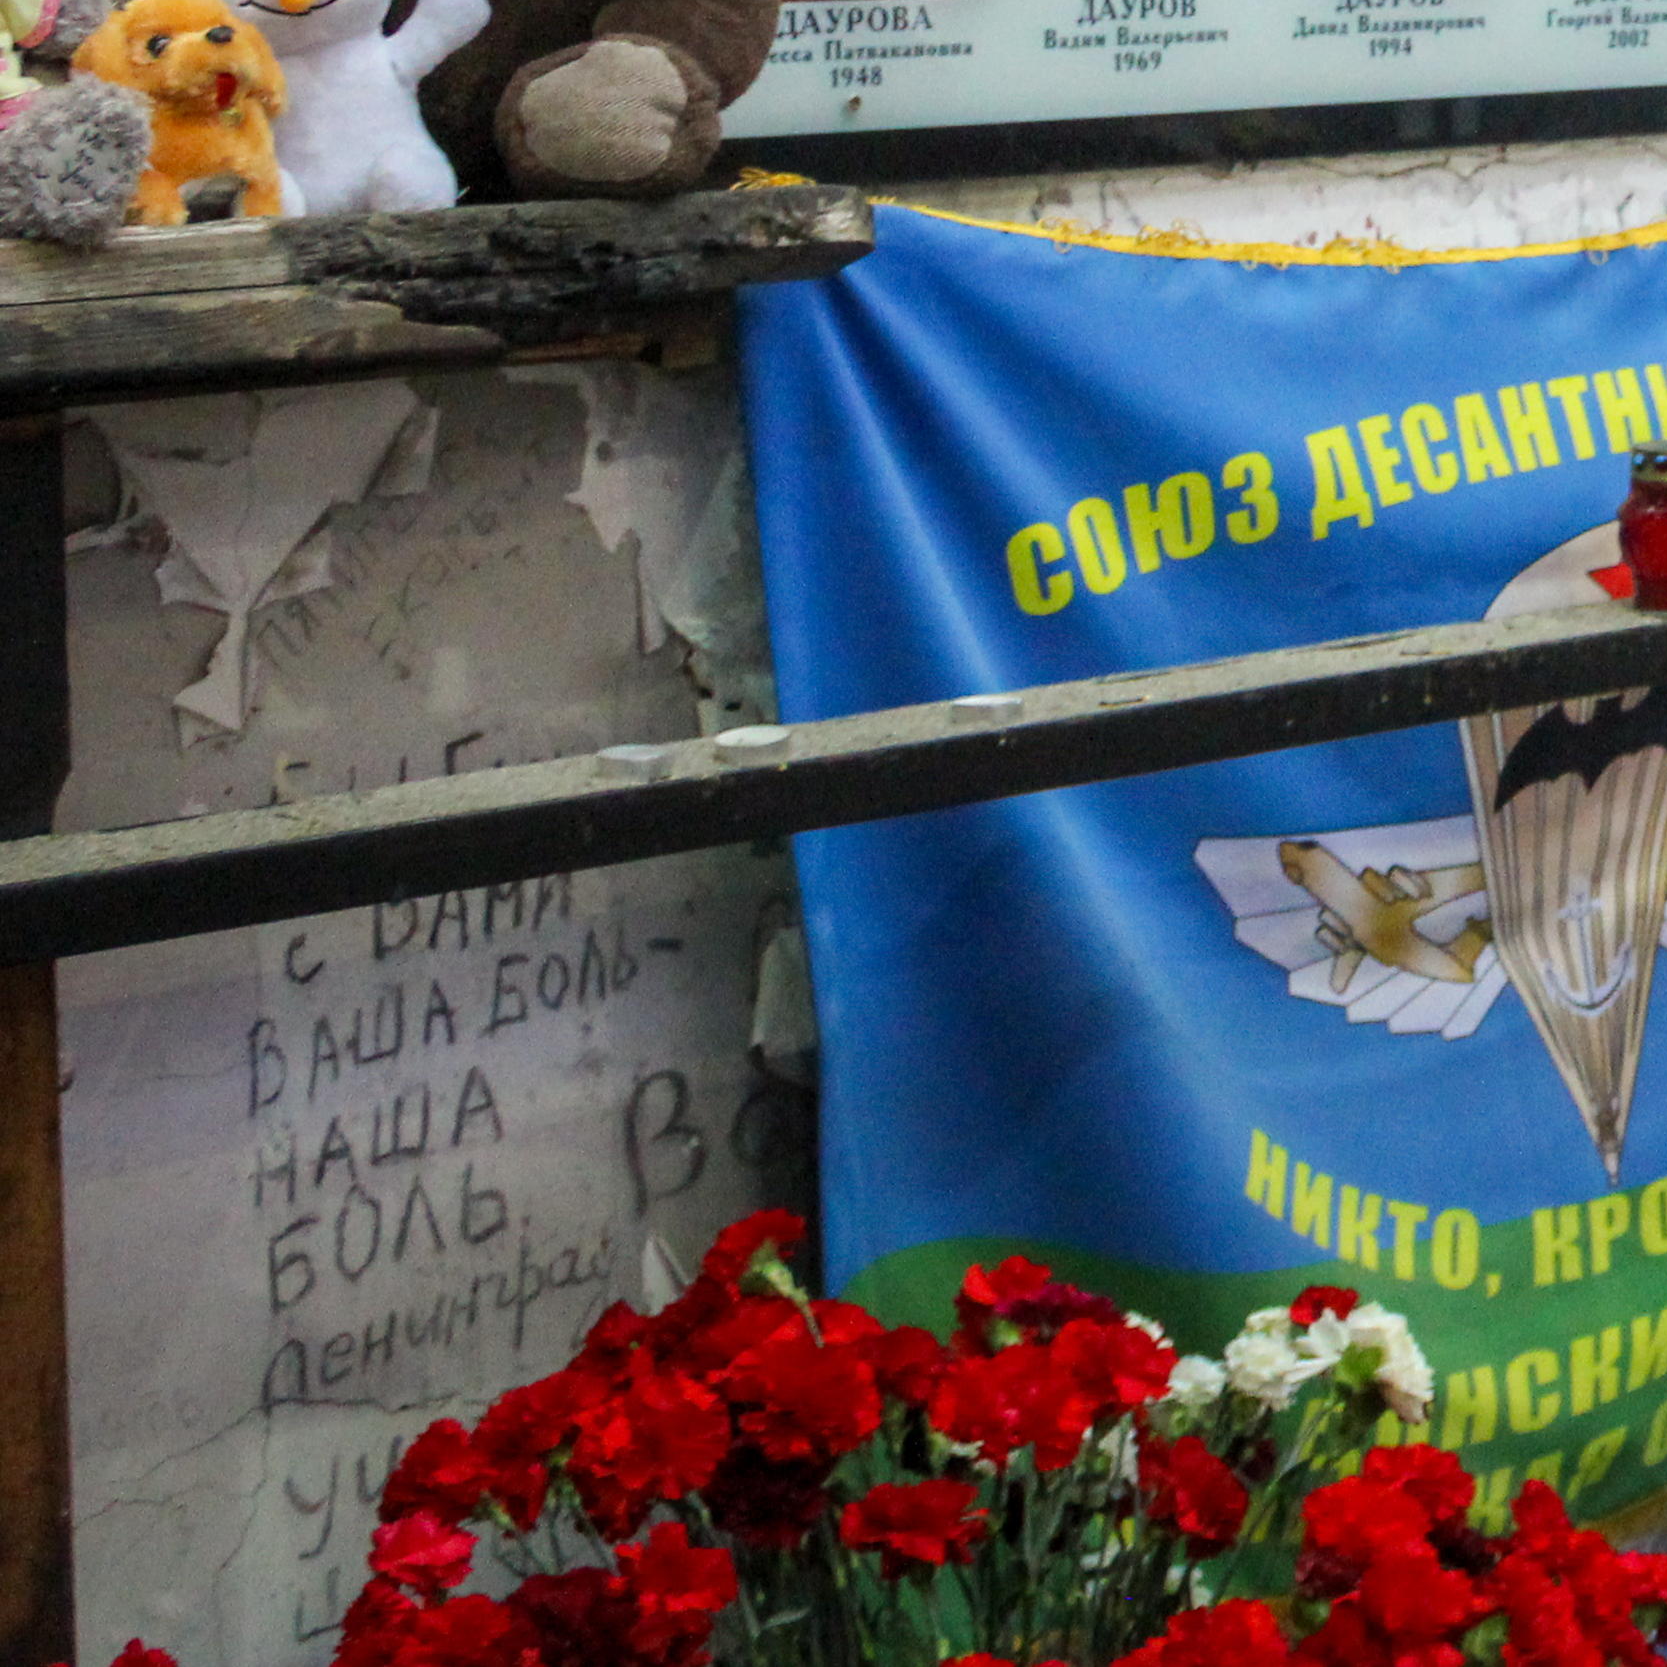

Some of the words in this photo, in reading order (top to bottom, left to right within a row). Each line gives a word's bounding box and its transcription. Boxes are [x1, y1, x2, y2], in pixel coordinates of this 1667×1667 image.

[778, 5, 933, 39] ДАУРОВА
[768, 46, 813, 64] есса
[1114, 50, 1161, 72] 1969
[1368, 38, 1413, 58] 1994
[830, 64, 883, 88] 1948
[1006, 449, 1278, 617] СОЮЗ
[248, 983, 456, 1120] ВАША
[251, 1065, 503, 1207] НАША
[1244, 1129, 1502, 1298] НИКТО,
